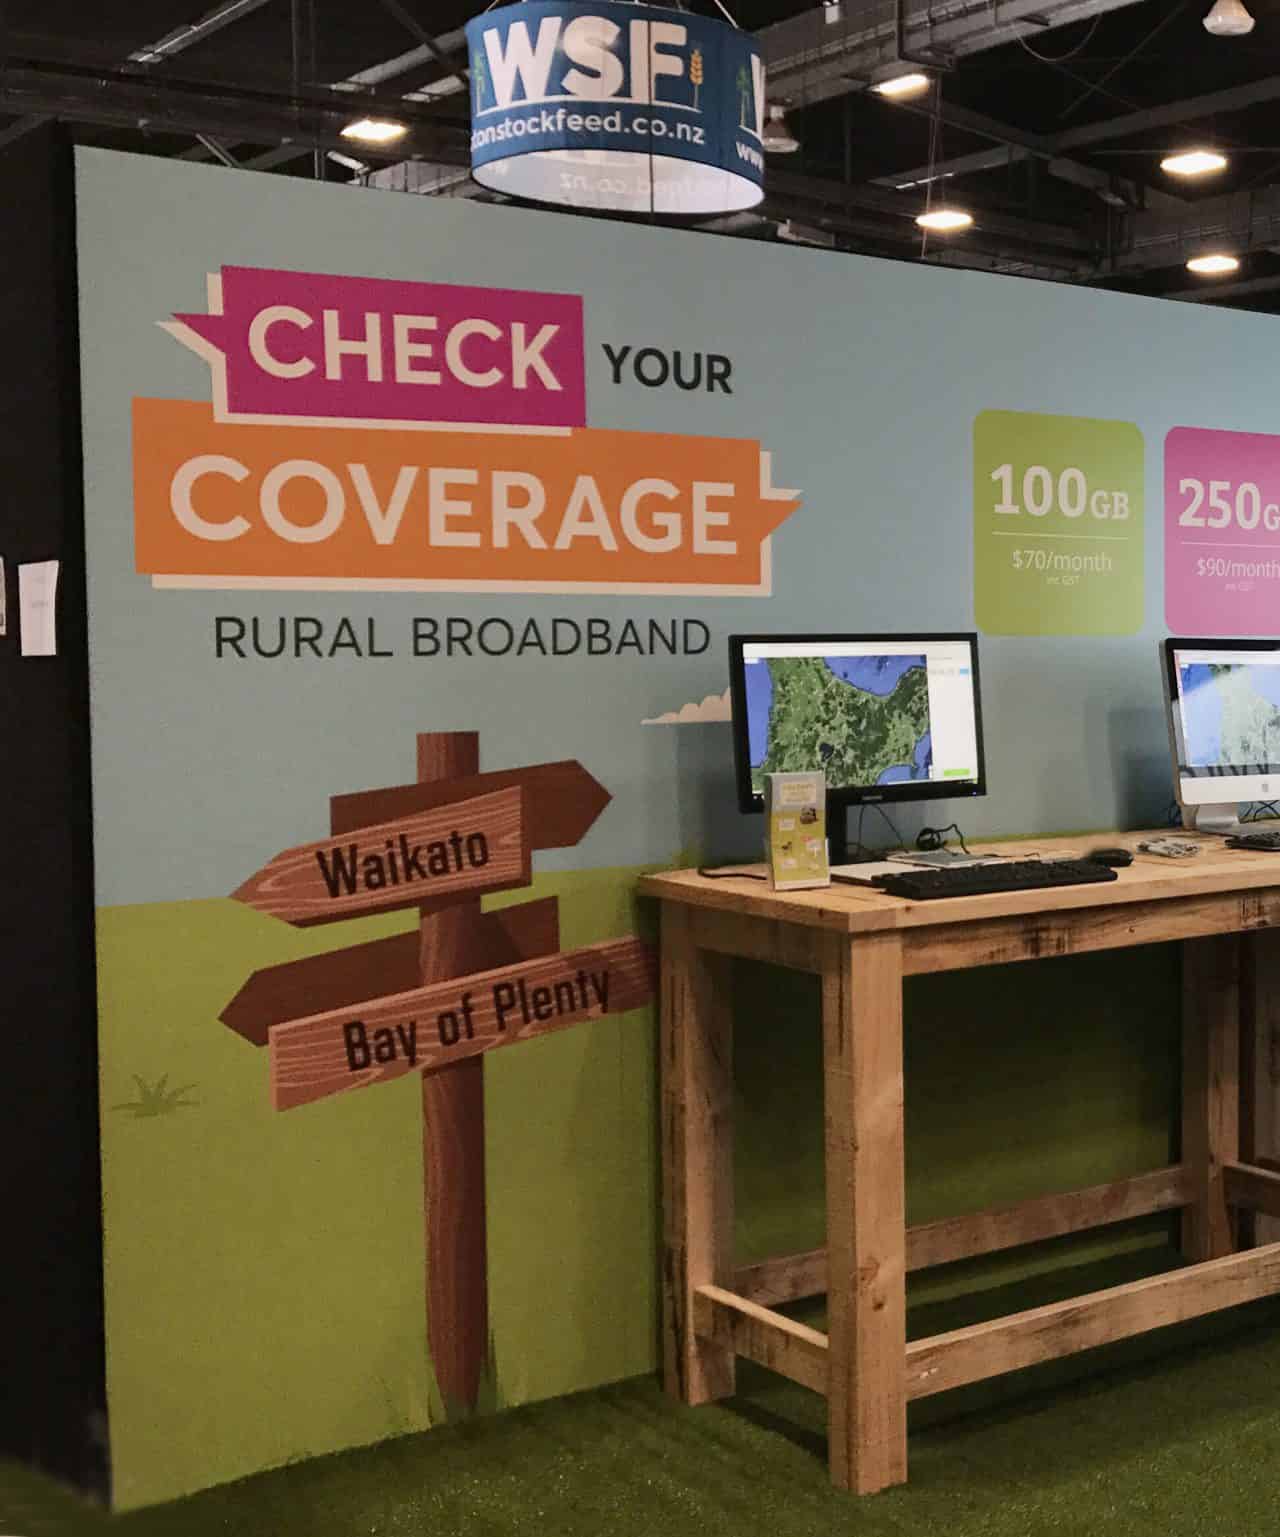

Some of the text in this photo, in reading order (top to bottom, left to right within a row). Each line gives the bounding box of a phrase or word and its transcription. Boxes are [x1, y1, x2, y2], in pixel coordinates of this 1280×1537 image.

[483, 15, 687, 104] WSF
[248, 304, 734, 395] CHECK YOUR
[170, 454, 738, 556] COVERAGE
[991, 463, 1129, 520] 100GB
[1012, 549, 1113, 571] $70/month
[1197, 557, 1280, 579] $90/month
[215, 616, 711, 659] RURAL BROADBAND
[316, 830, 490, 898] Waikato
[343, 970, 610, 1072] Bay of Plenty
